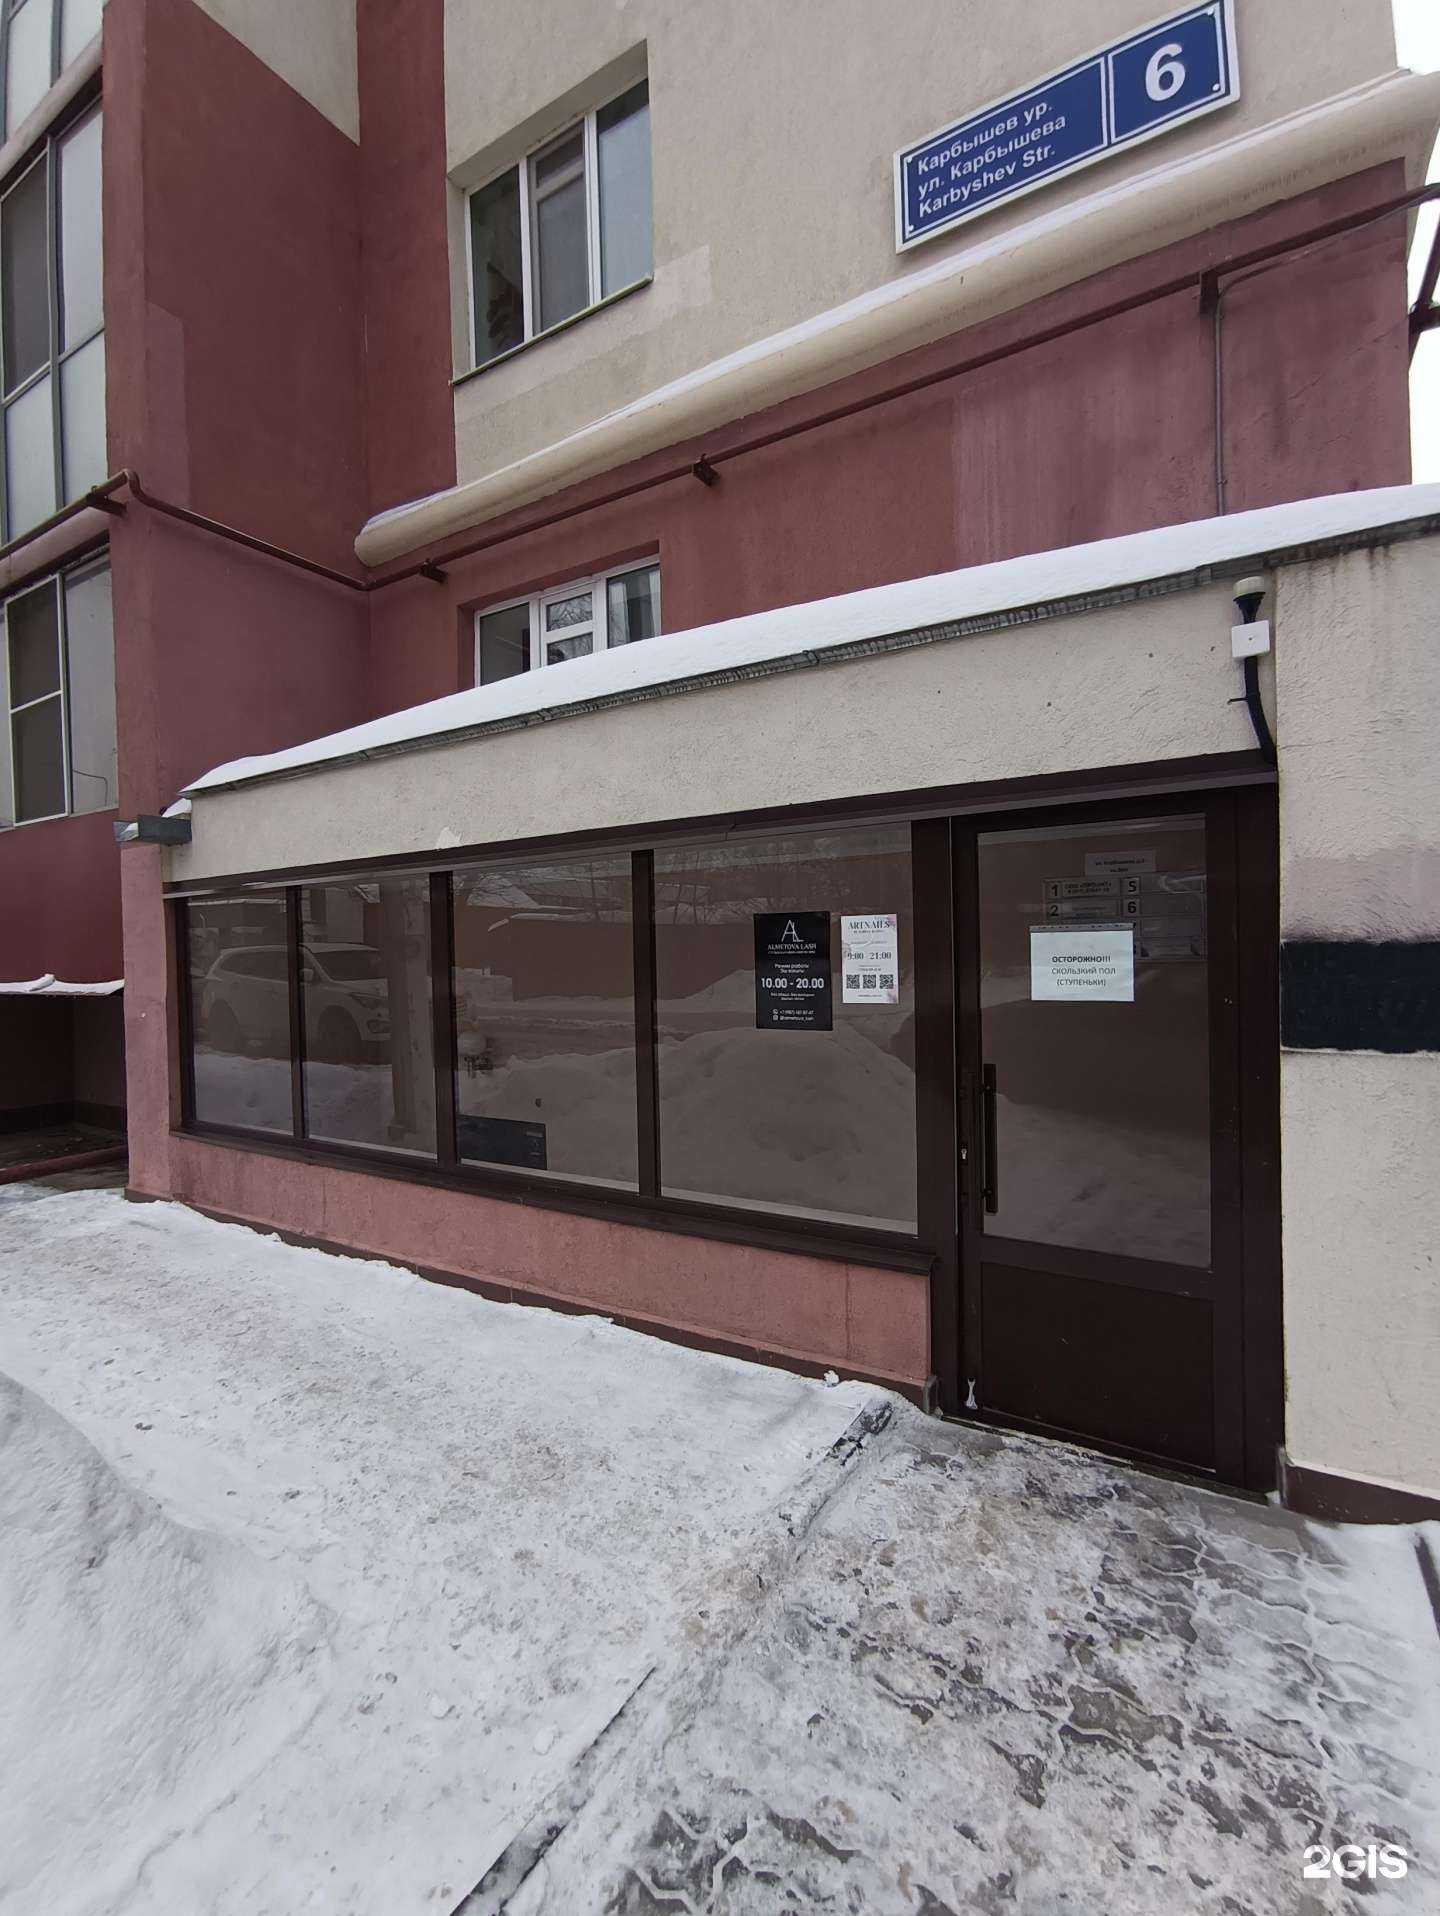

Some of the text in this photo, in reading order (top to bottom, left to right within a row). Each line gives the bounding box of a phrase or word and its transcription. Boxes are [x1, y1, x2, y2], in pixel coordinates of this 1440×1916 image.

[1145, 43, 1186, 102] 6
[918, 101, 1053, 175] Карбышев ур.
[918, 115, 1066, 200] ул. Карбышева
[919, 145, 1056, 218] Karbyshev Str.
[1051, 884, 1058, 897] 1
[1128, 880, 1137, 893] 5
[1050, 904, 1059, 917] 2
[1127, 901, 1137, 914] 6
[868, 951, 892, 960] 21:00
[1051, 955, 1111, 963] ОСТОРОЖНО!!!
[1051, 967, 1116, 975] СКОЛЬЗКИЙ ПОЛ
[761, 977, 788, 989] 10.00
[795, 977, 825, 989] 20.00
[1056, 978, 1106, 987] (СТУПЕНЬКИ)
